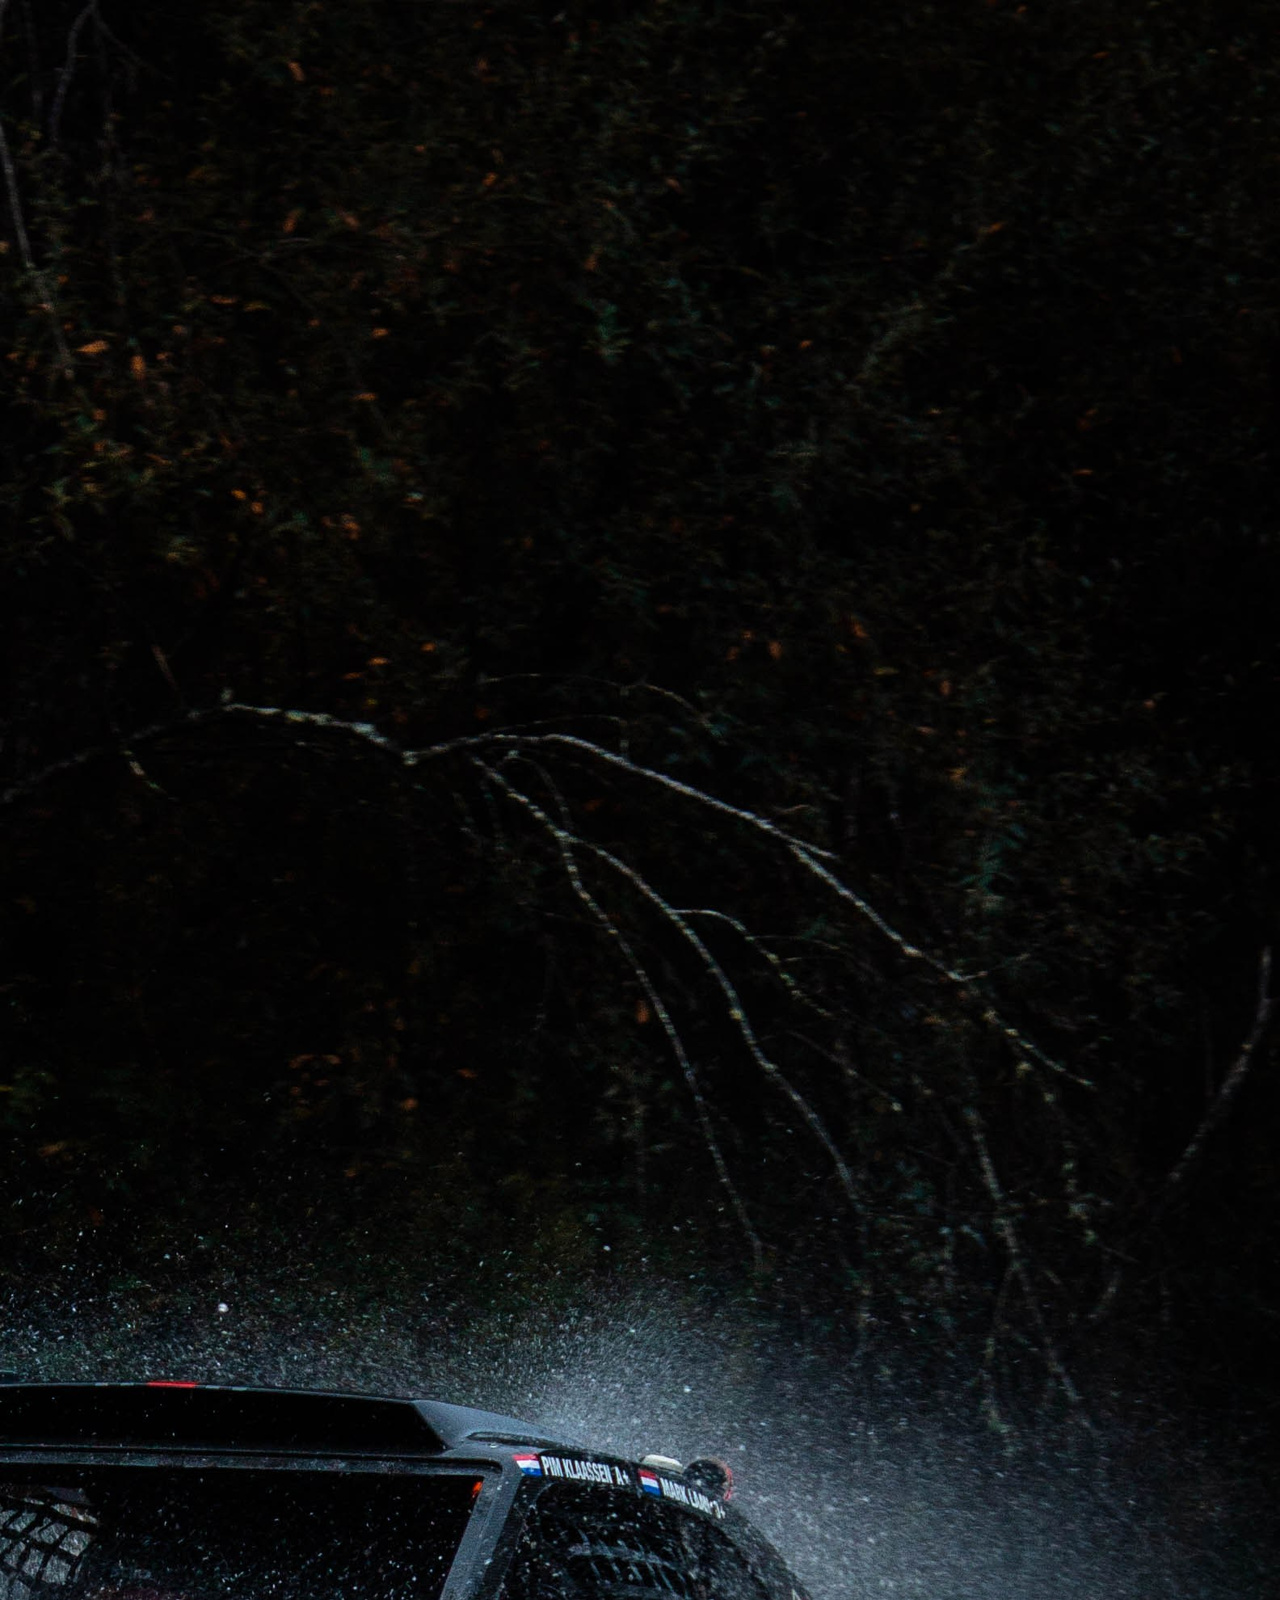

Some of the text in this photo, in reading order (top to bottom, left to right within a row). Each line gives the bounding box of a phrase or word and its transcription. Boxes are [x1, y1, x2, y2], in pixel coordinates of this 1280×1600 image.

[541, 1456, 562, 1476] PIM
[562, 1459, 612, 1484] KLAASSEN
[660, 1477, 690, 1505] MARK
